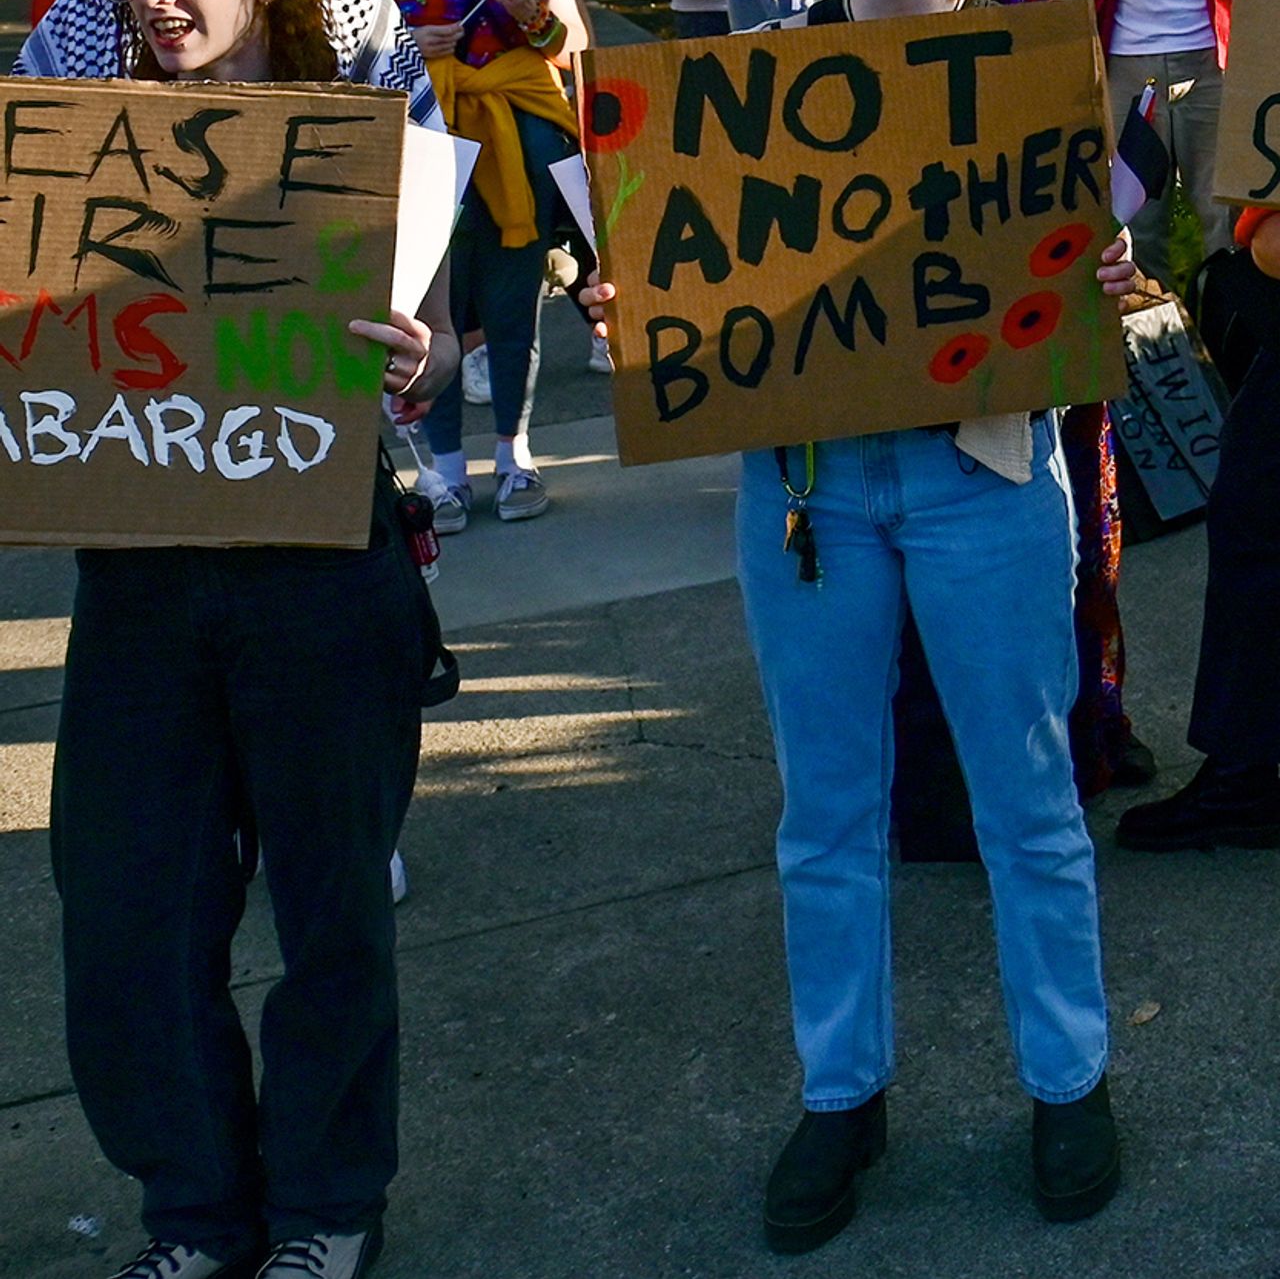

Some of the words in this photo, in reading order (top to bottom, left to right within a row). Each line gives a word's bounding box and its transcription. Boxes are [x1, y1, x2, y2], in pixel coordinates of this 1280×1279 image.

[672, 29, 1014, 161] NOT
[213, 310, 389, 400] NOW
[645, 251, 992, 423] BOMB
[1147, 335, 1221, 458] DIME
